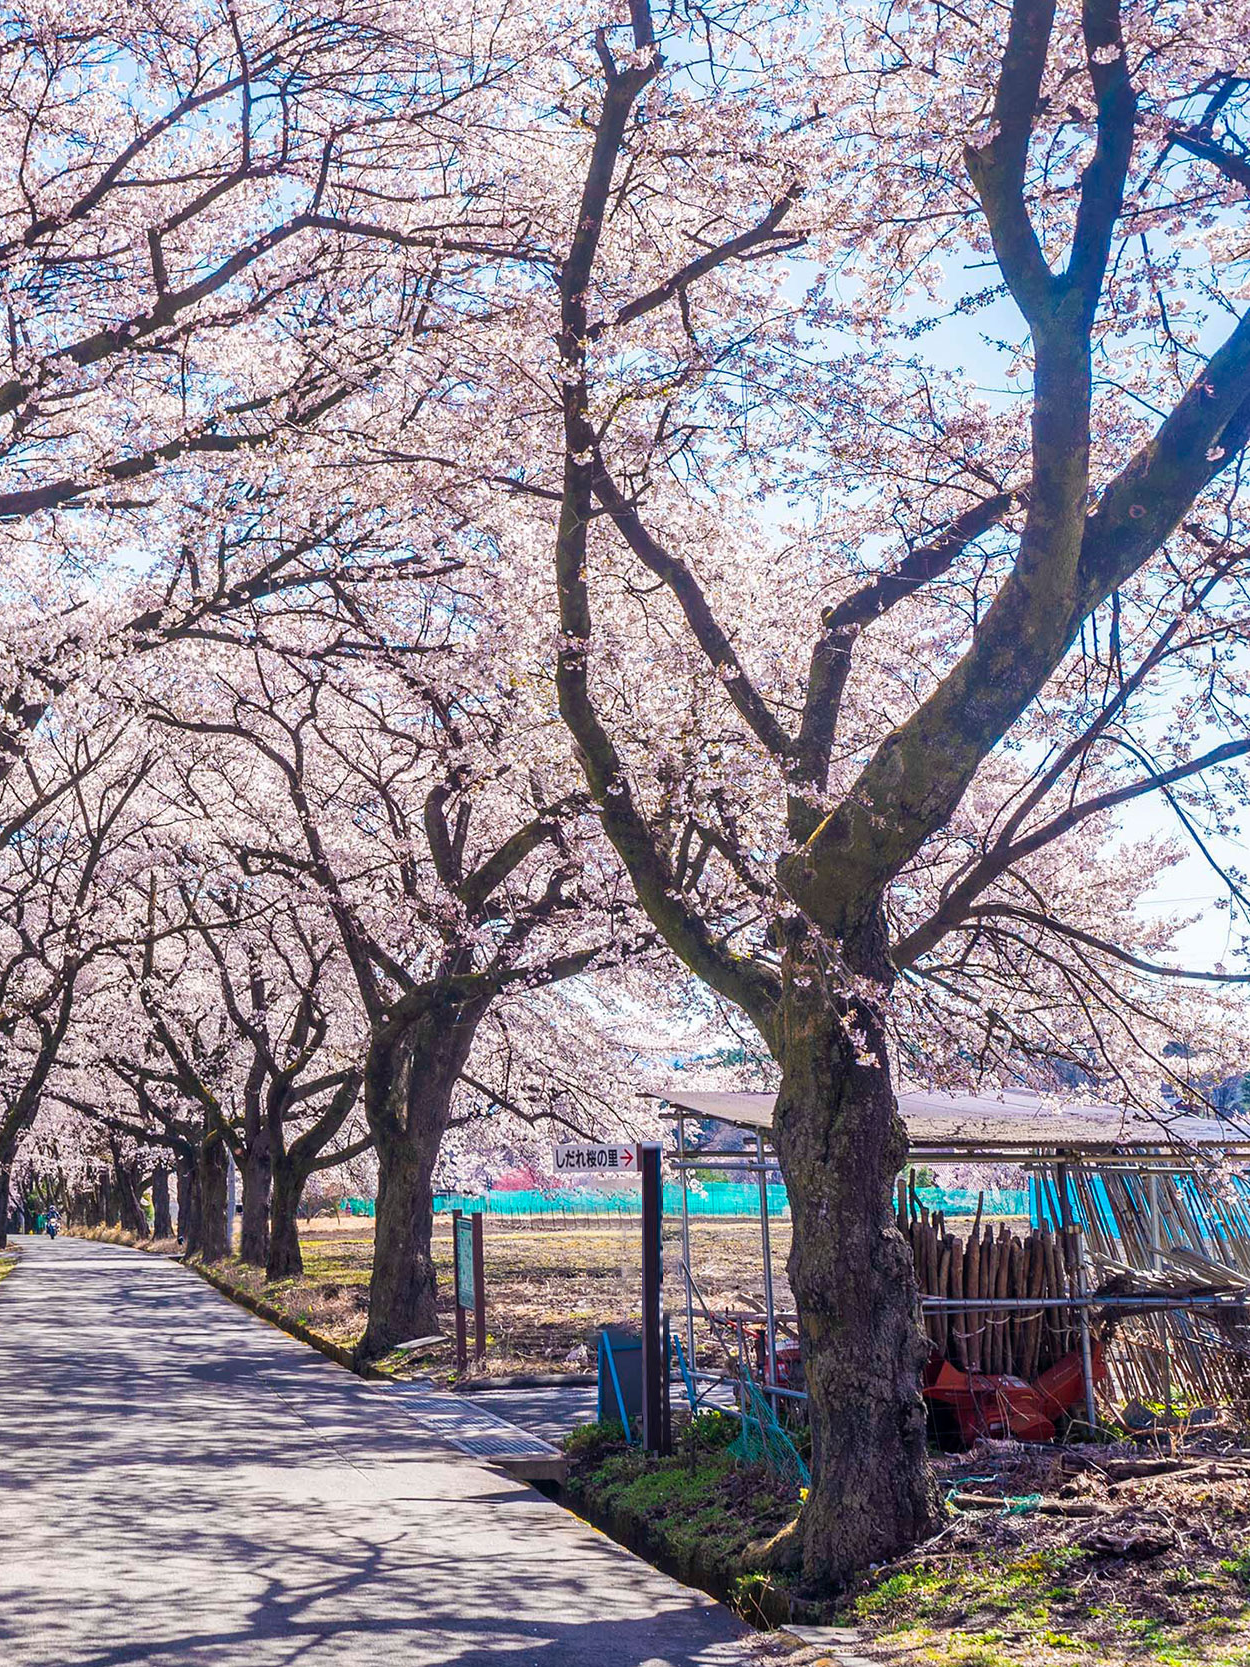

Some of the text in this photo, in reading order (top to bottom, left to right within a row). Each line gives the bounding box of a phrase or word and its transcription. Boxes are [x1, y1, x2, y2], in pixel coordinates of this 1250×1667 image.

[555, 1149, 618, 1168] しだれ桜の里
